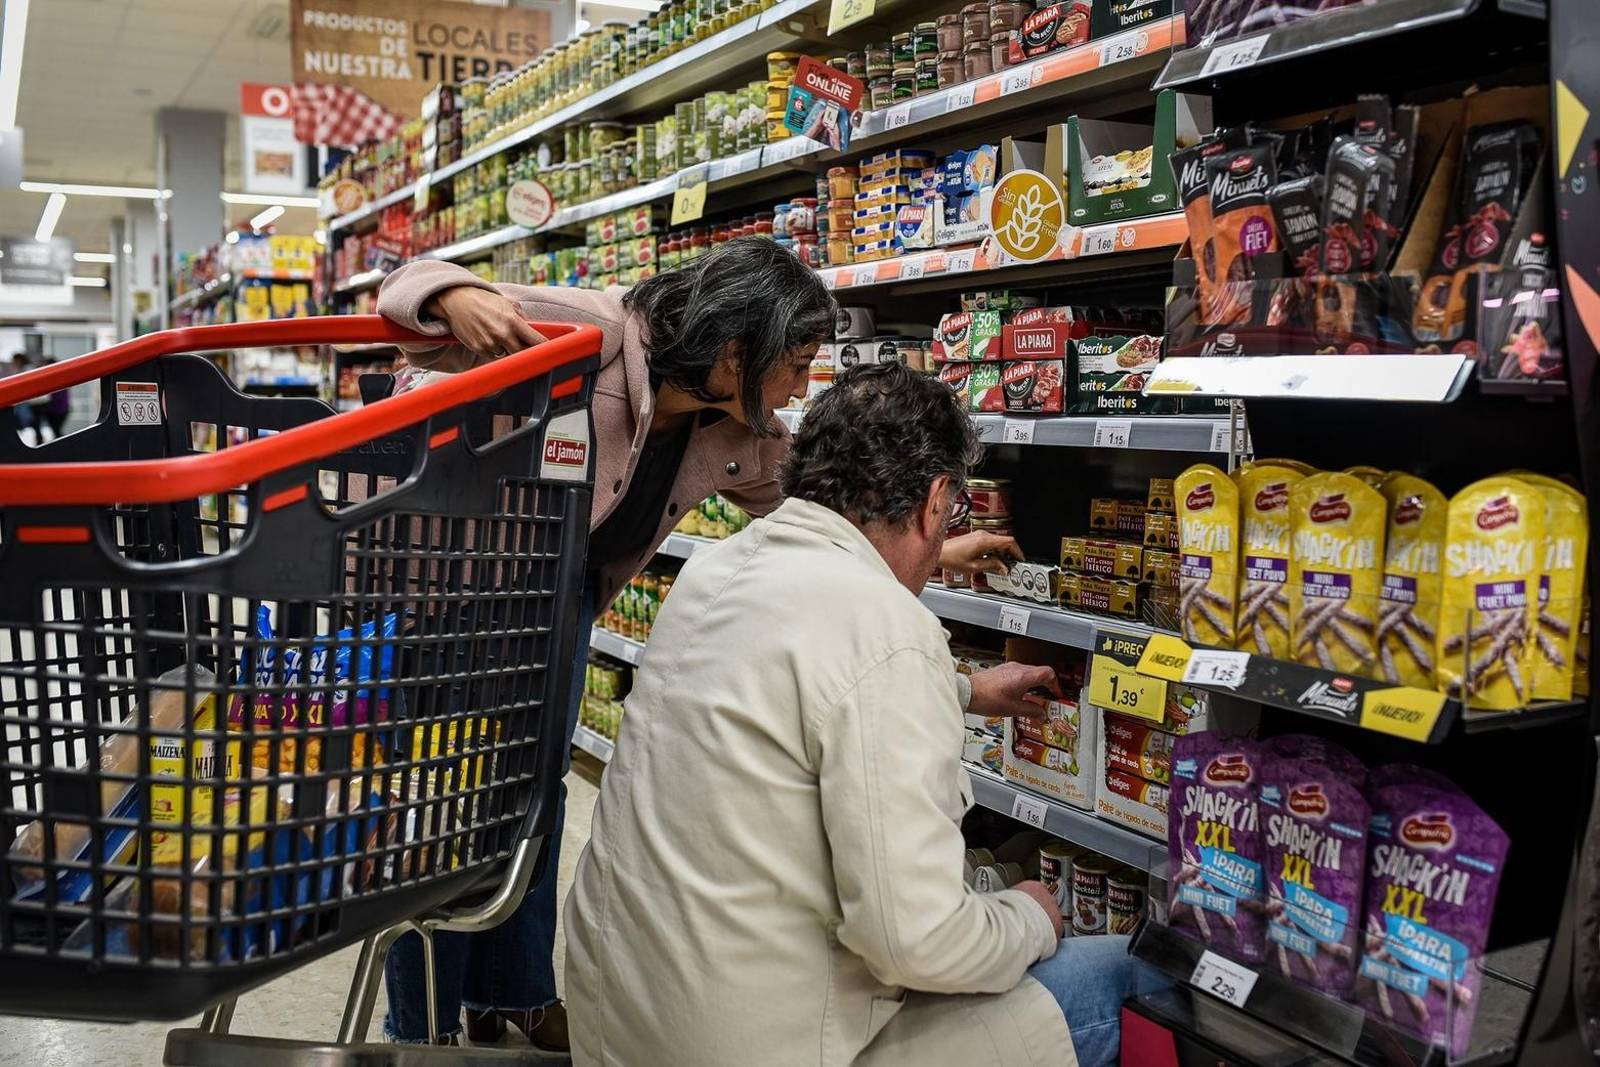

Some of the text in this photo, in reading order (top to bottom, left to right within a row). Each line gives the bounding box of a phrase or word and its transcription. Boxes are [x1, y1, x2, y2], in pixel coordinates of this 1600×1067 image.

[303, 10, 409, 34] PRODUCTOS
[1036, 6, 1059, 26] PIARA
[1120, 8, 1154, 26] Iberitos
[380, 36, 409, 57] DE
[413, 23, 540, 57] LOCALES
[304, 51, 412, 82] NUESTRA
[806, 73, 852, 101] ONLINE
[1211, 165, 1268, 200] Minuets
[1001, 186, 1017, 202] Sin
[1041, 224, 1058, 239] Free
[943, 314, 970, 331] LA PIARA
[1022, 310, 1042, 324] PIARA
[975, 328, 998, 336] GRASA
[1018, 334, 1052, 348] LA PIARA
[1078, 342, 1112, 354] Iberitos
[1004, 364, 1034, 381] LA PIARA
[1097, 396, 1137, 409] Iberitos
[547, 441, 584, 462] el jamón
[1149, 652, 1188, 670] ¡NUEVO!
[1110, 674, 1138, 708] 1,39
[1098, 798, 1114, 814] Paté
[1142, 818, 1149, 826] de
[1194, 820, 1236, 853] XXL
[1212, 850, 1256, 885] ¡PARA
[1280, 852, 1316, 890] XXL
[1074, 882, 1100, 895] Cocktail
[1380, 884, 1428, 924] XXL
